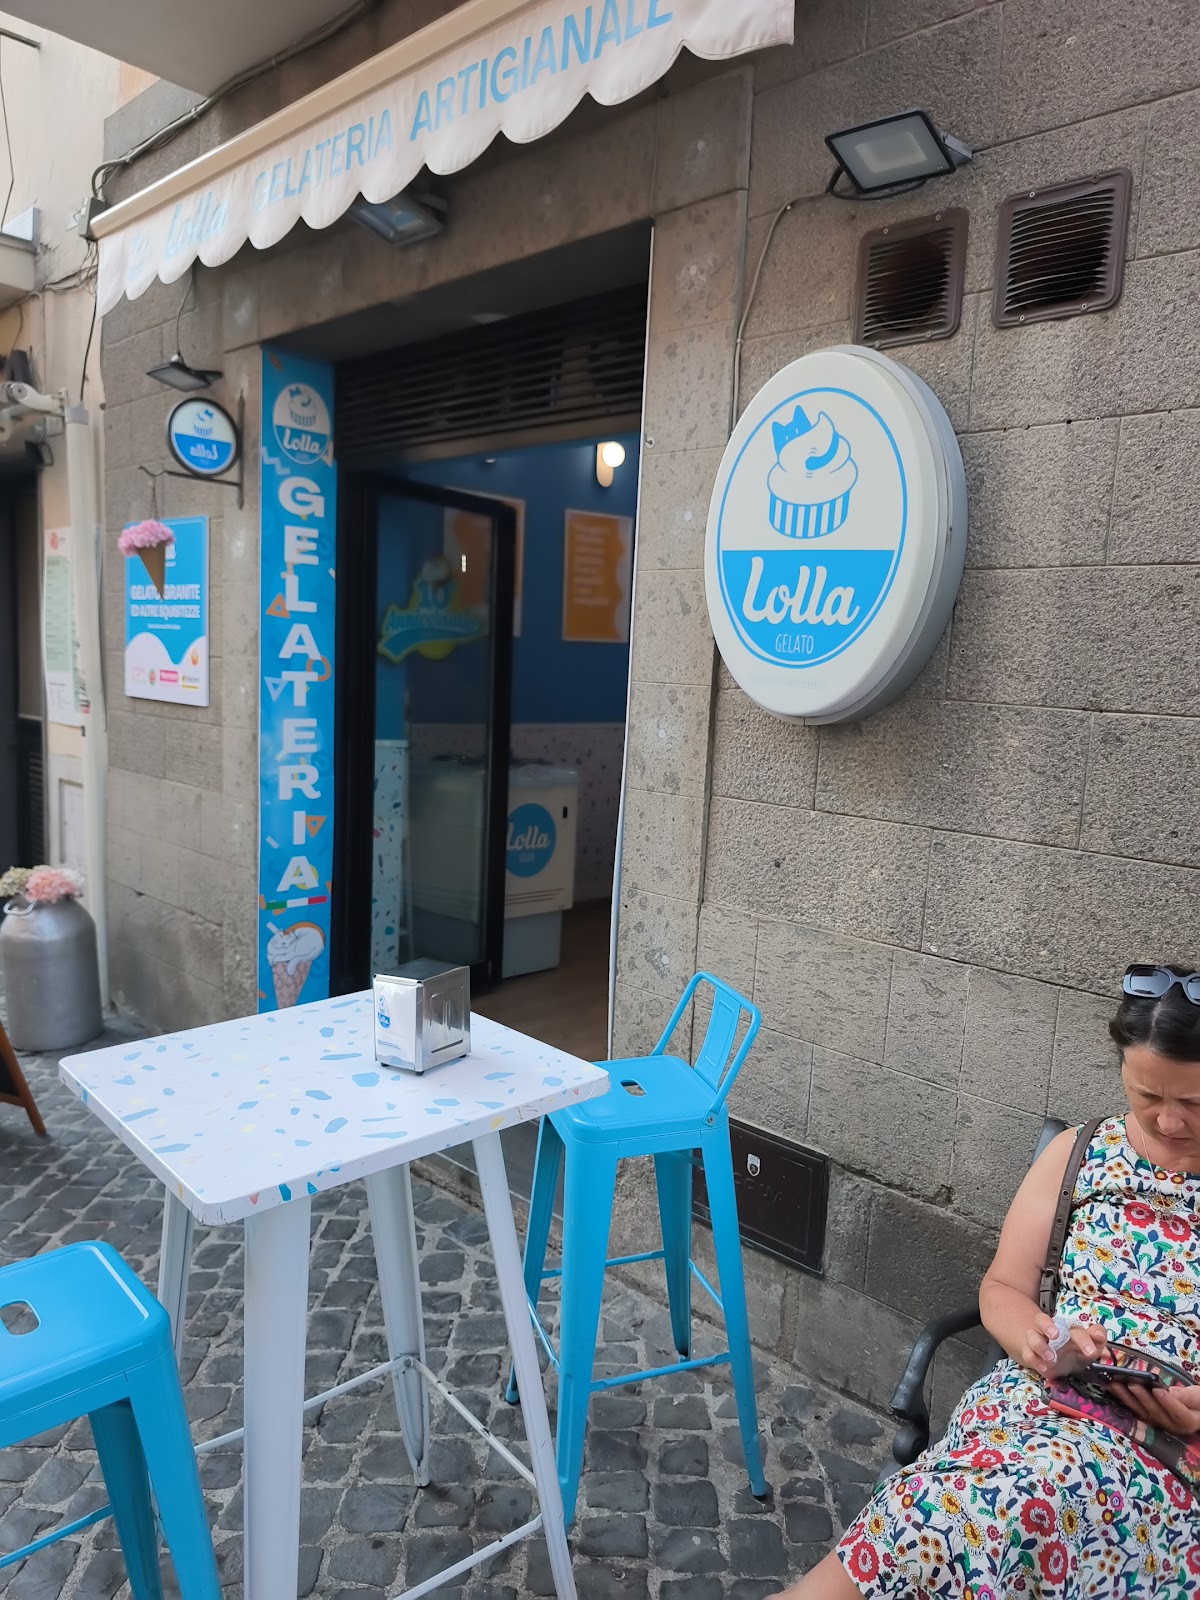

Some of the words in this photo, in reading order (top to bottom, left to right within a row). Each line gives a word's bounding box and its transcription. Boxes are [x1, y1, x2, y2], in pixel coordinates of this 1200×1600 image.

[166, 191, 229, 258] Lolla
[252, 109, 392, 214] GELATERIA
[283, 427, 322, 455] Lolla
[742, 556, 860, 626] Lolla
[775, 633, 815, 655] GELATO
[278, 476, 325, 893] GELATERIA
[506, 822, 551, 851] Lolla
